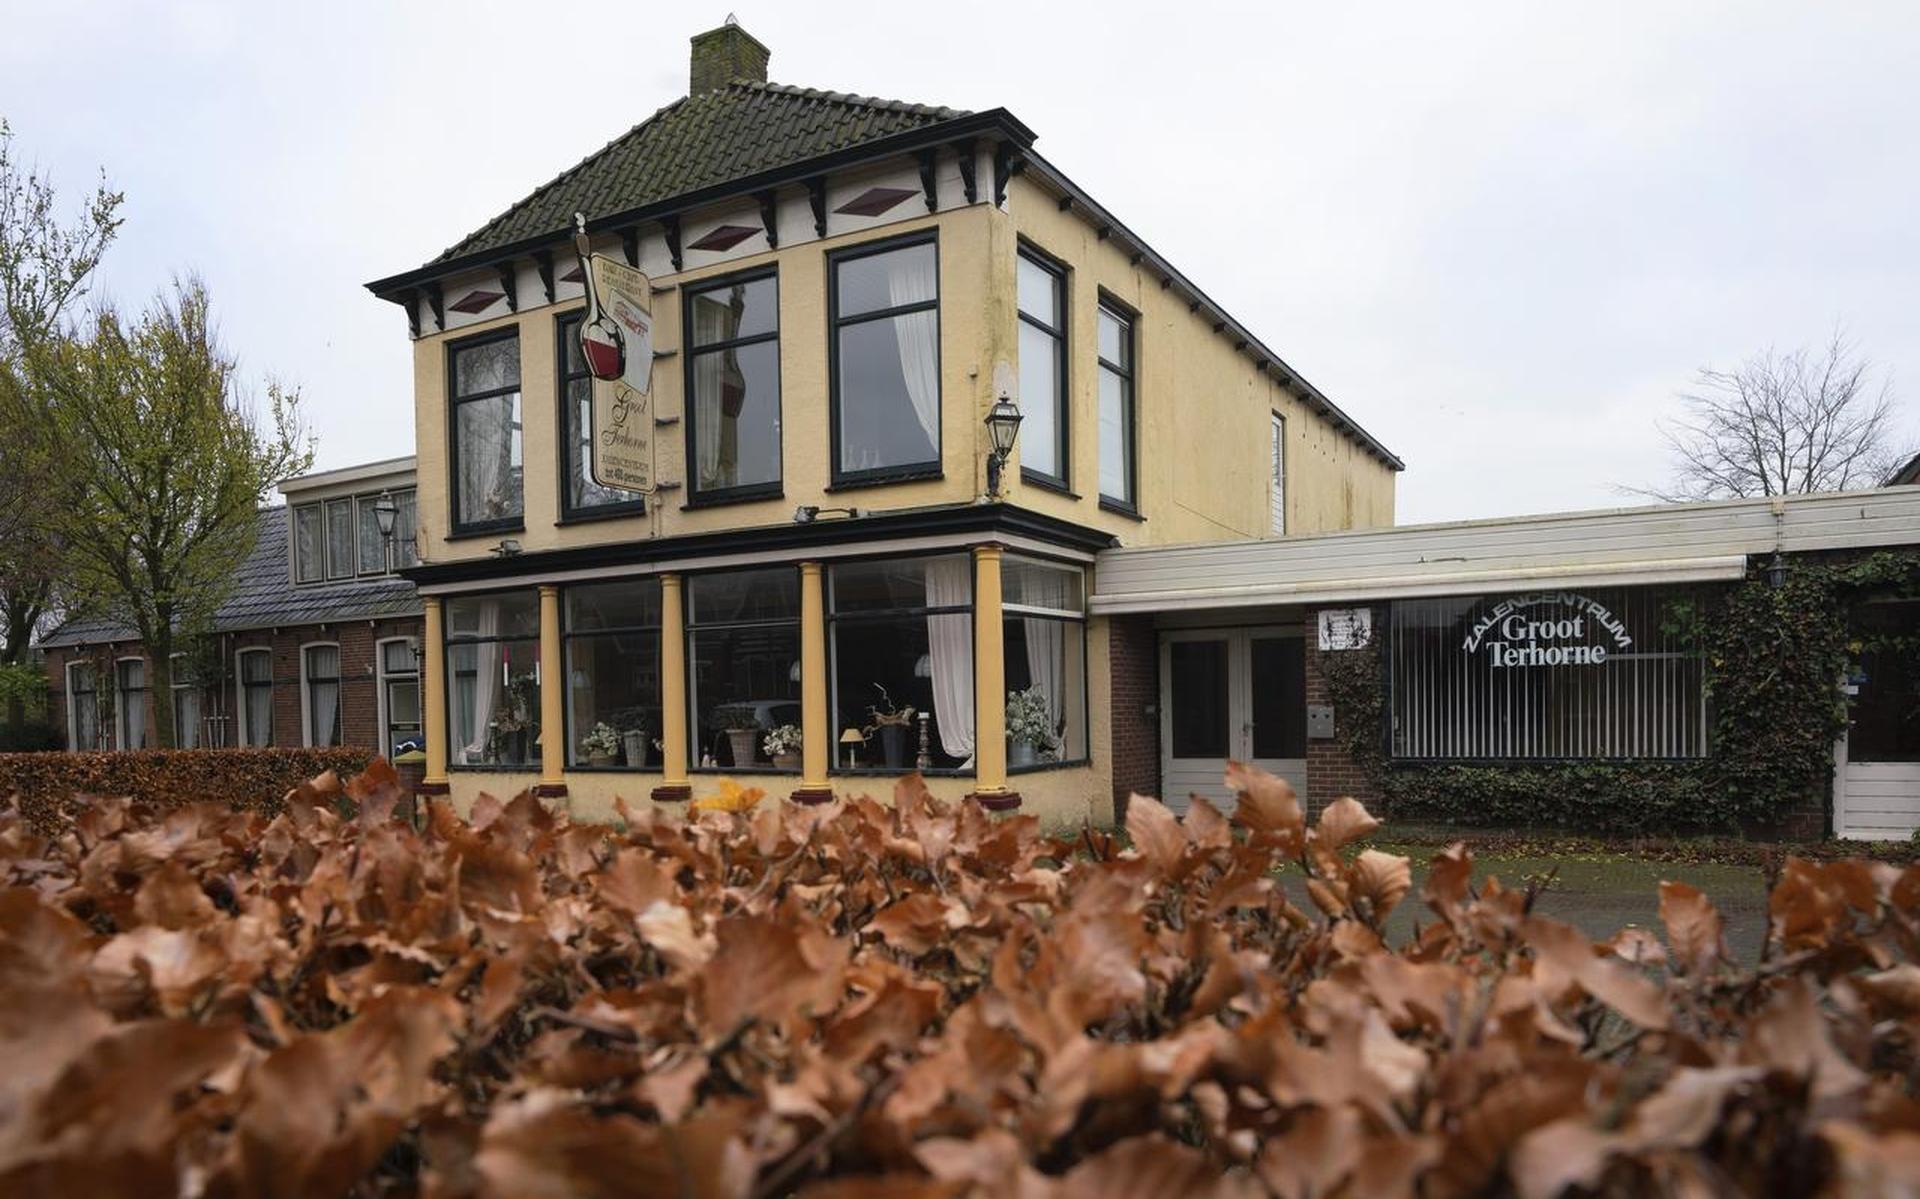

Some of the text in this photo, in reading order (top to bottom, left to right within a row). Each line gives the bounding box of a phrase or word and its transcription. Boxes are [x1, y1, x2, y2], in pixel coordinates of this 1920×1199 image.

[1462, 592, 1632, 653] ZALENCENTRUM
[1502, 614, 1584, 641] Groot
[1486, 640, 1606, 667] Terhorne
